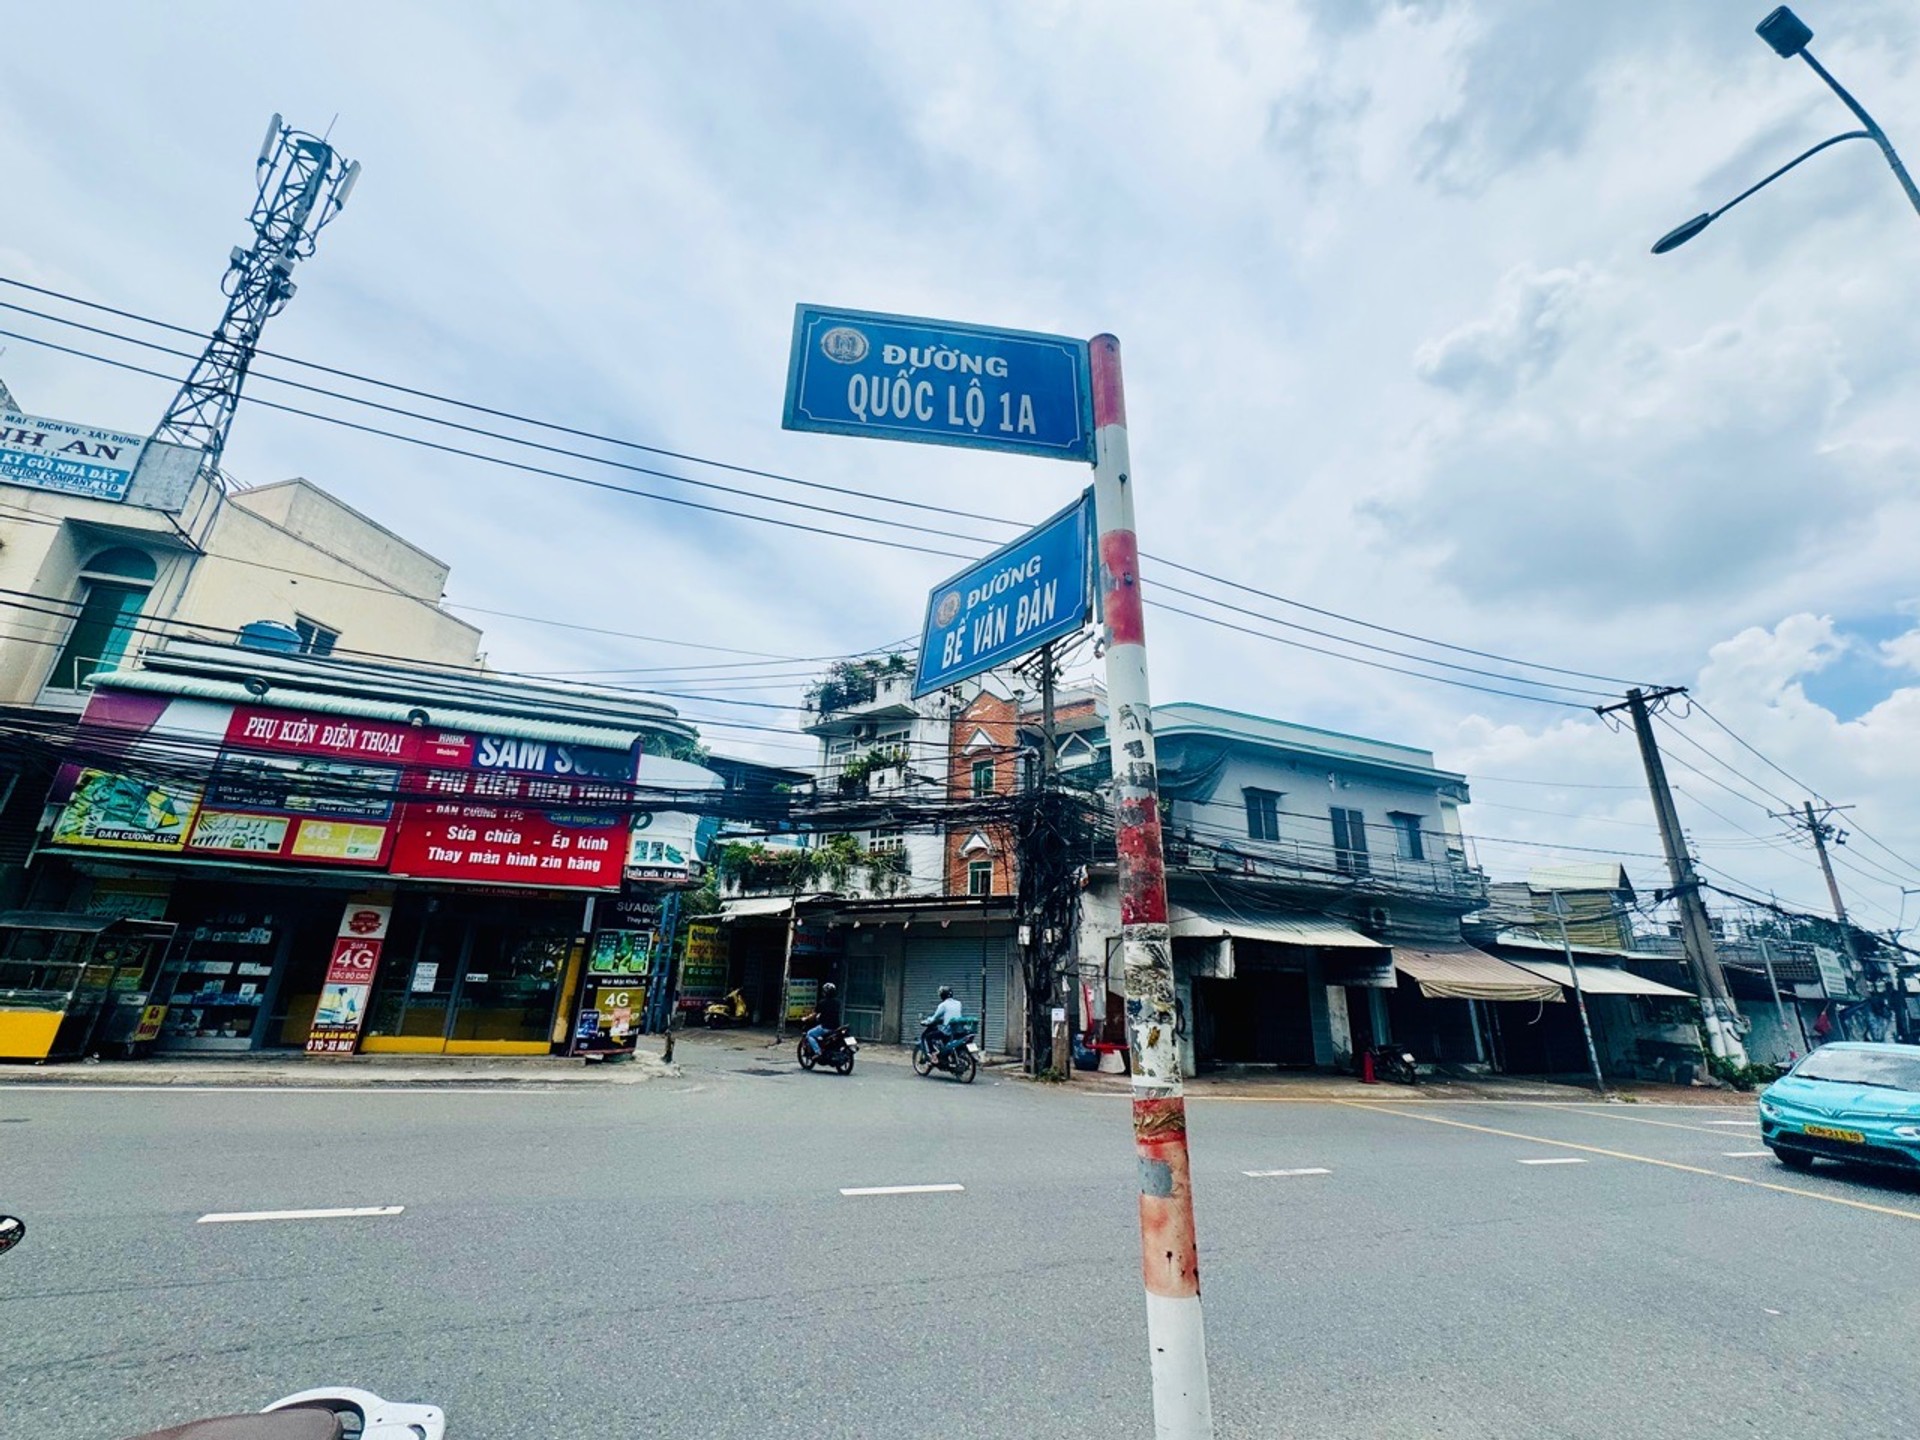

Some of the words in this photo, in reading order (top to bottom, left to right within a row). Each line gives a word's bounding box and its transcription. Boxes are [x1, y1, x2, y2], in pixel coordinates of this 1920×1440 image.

[882, 343, 1008, 378] ĐƯỜNG
[848, 367, 934, 422] QUỐC
[948, 379, 985, 433] LỘ
[999, 392, 1036, 435] 1A
[59, 440, 123, 461] AN
[967, 554, 1042, 610] ĐƯỜNG
[941, 611, 971, 670] BẾ
[973, 603, 1008, 656] VĂN
[1015, 578, 1058, 637] ĐÀN
[243, 716, 279, 744] PHỤ
[279, 717, 319, 747] KIỆN
[320, 722, 358, 751] ĐIỆN
[360, 730, 404, 756] THOẠI
[478, 736, 547, 771] SAM
[447, 824, 477, 842] Sửa
[484, 827, 522, 845] chữa
[551, 830, 570, 849] Ép
[577, 834, 609, 851] kính
[427, 847, 462, 864] Thay
[468, 849, 501, 865] màn
[506, 851, 537, 867] hình
[540, 855, 562, 869] zin
[567, 856, 601, 873] hãng
[336, 949, 374, 969] 4G
[605, 992, 629, 1008] 4G
